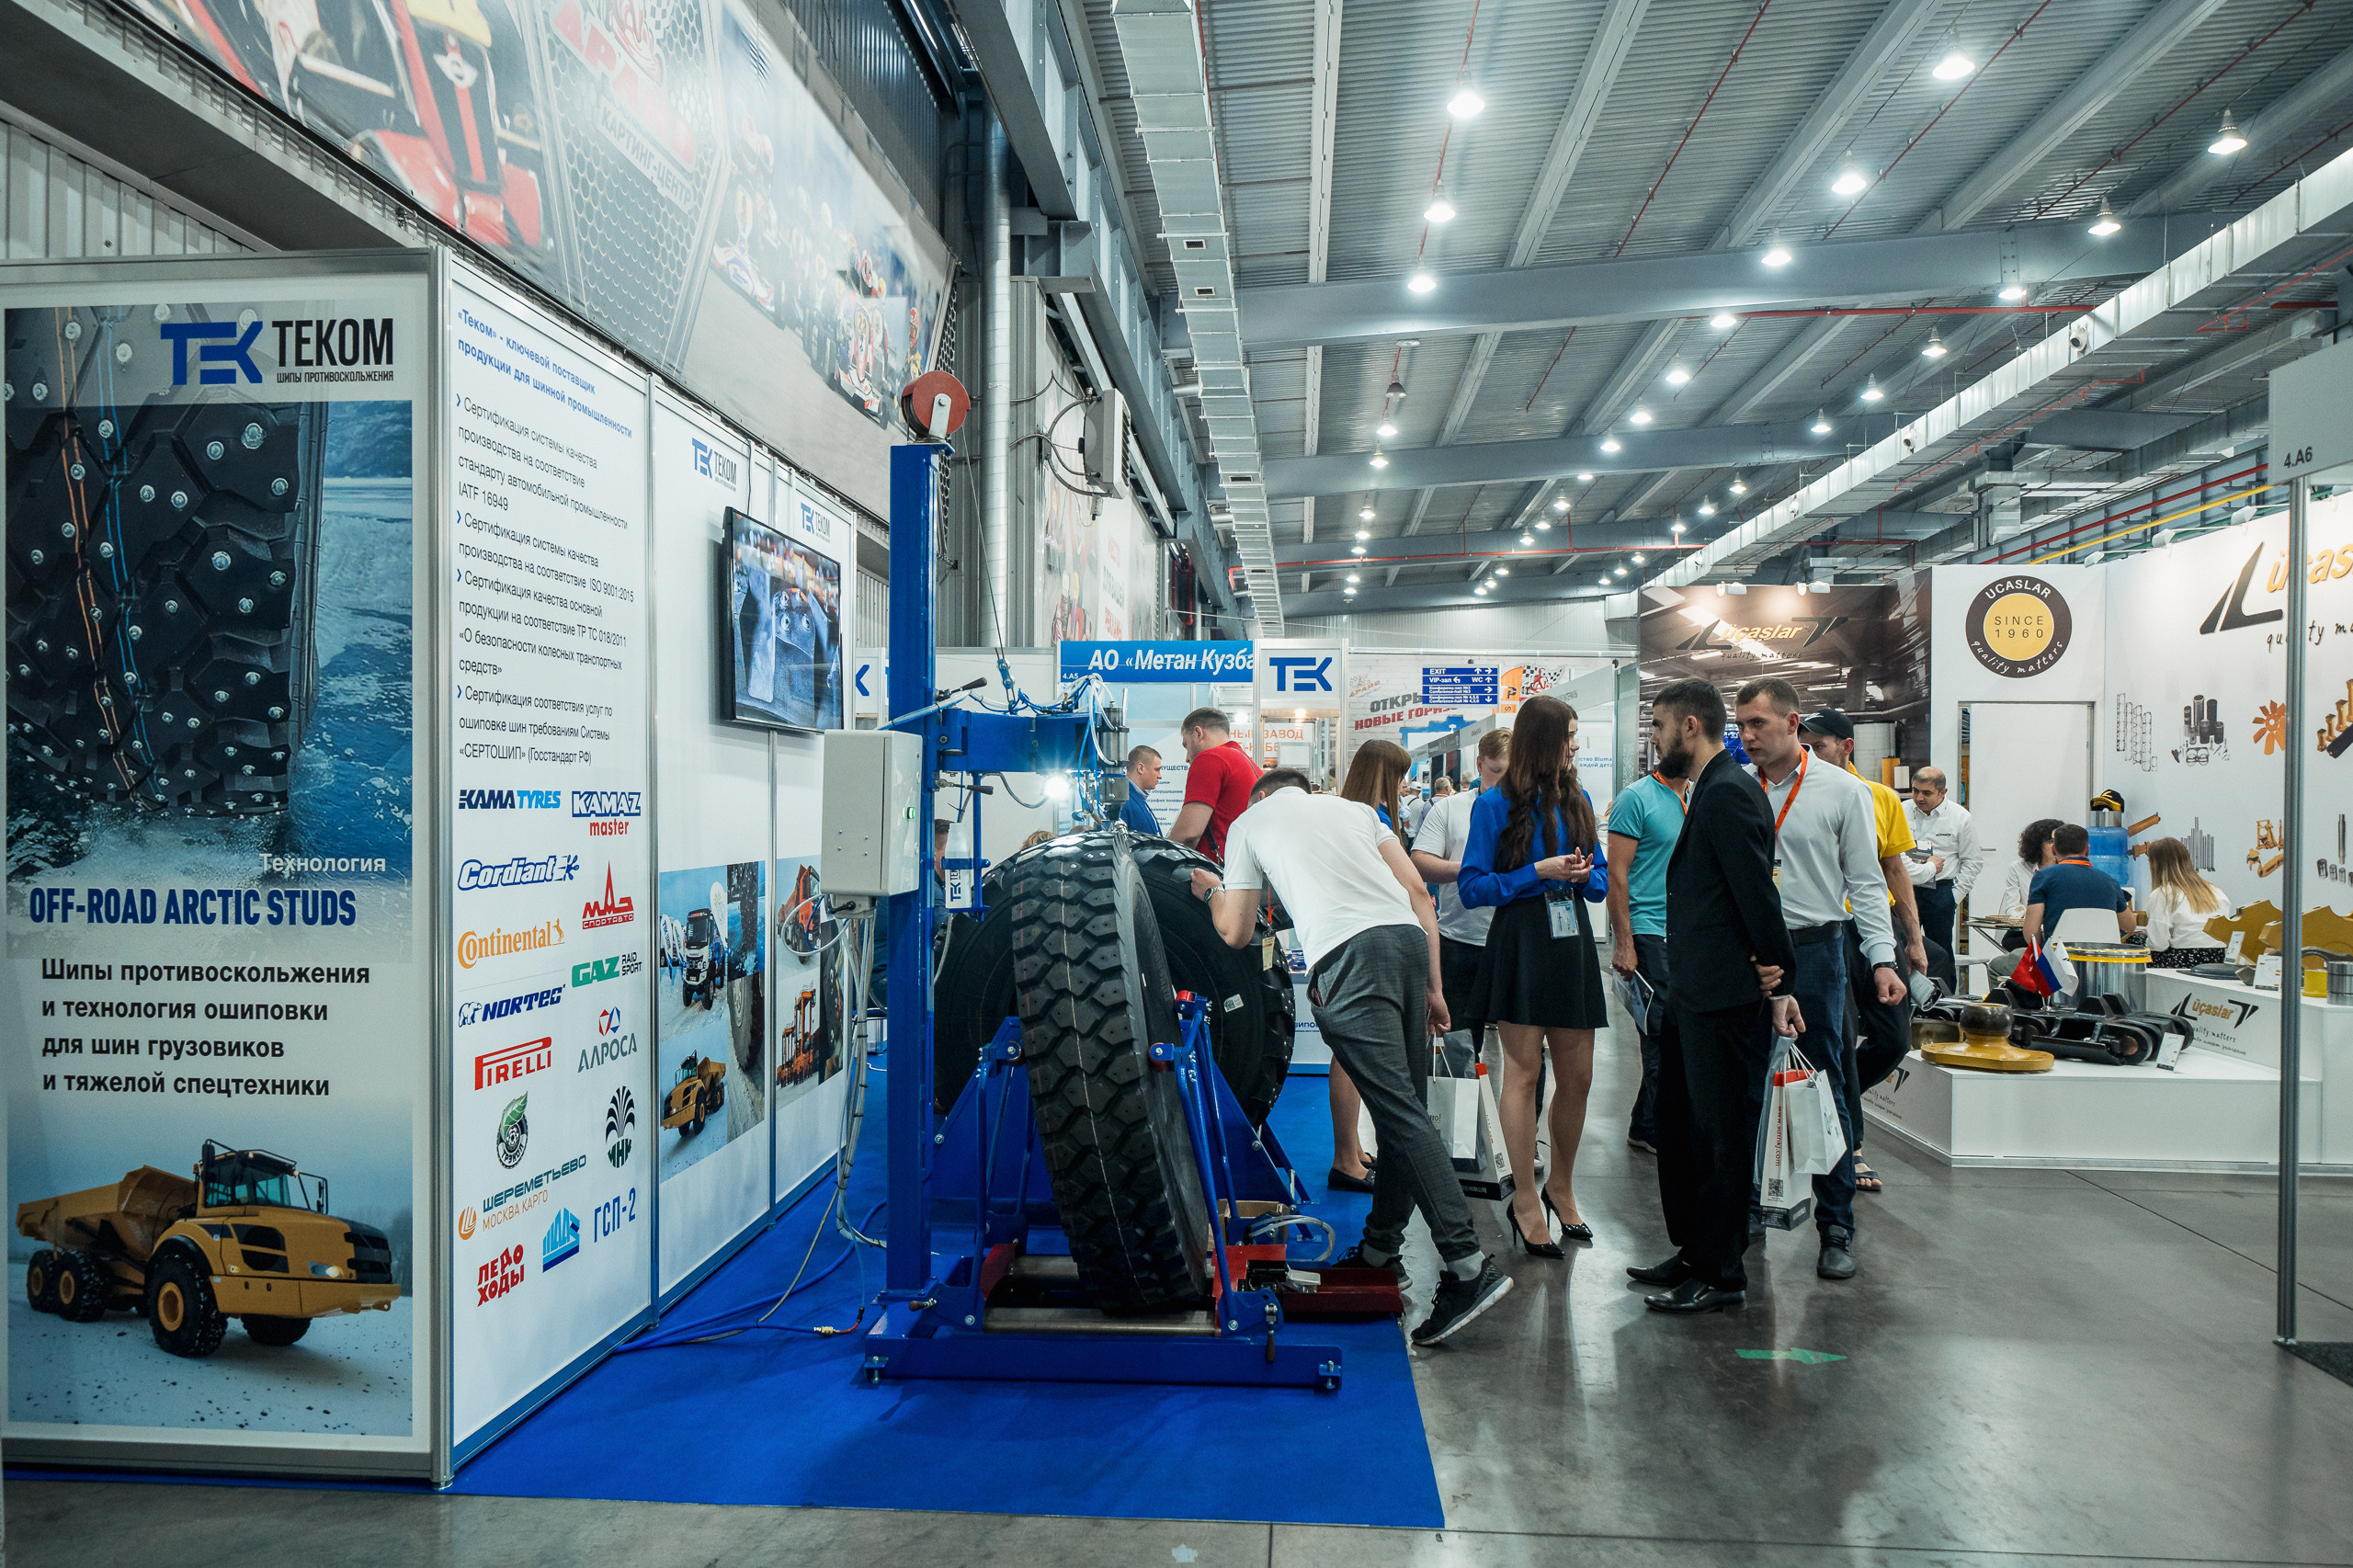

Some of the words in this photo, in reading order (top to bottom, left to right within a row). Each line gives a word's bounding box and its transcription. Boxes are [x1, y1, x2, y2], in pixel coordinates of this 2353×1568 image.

[602, 106, 694, 206] КАРТИНГ-ЦЕНТР
[272, 318, 393, 367] ТЕКОМ
[459, 308, 496, 338] «Теком»
[506, 336, 550, 369] ключевой
[552, 362, 596, 394] поставщик
[277, 371, 301, 383] ШИПЫ
[304, 369, 393, 382] ПРОТИВОСКОЛЬЖЕНИЯ
[459, 339, 511, 375] продукции
[514, 368, 529, 384] для
[533, 378, 565, 403] шинной
[568, 396, 631, 438] промышленности
[464, 397, 529, 437] Сертификация
[531, 430, 563, 453] системы
[566, 447, 597, 469] качества
[459, 426, 521, 462] производства
[524, 455, 533, 467] на
[536, 458, 585, 488] соответствие
[714, 451, 736, 484] ТЕКОМ
[2284, 446, 2312, 468] 4.A6
[459, 456, 505, 484] стандарту
[507, 472, 569, 506] автомобильной
[571, 497, 628, 529] промышленности
[459, 481, 479, 500] IATF
[483, 490, 508, 511] 16949
[464, 513, 530, 546] Сертификация
[533, 536, 565, 556] системы
[568, 548, 598, 568] качества
[460, 543, 522, 570] производства
[525, 562, 535, 573] на
[537, 564, 586, 588] соответствие
[589, 578, 601, 593] ISO
[603, 583, 634, 602] 9001:2015
[2266, 543, 2353, 593] üas
[465, 571, 531, 599] Сертификация
[534, 585, 568, 609] качества
[570, 600, 602, 618] основной
[1985, 579, 2052, 599] UCASLAR
[460, 601, 509, 621] продукции
[512, 612, 521, 623] на
[524, 614, 575, 636] соответствие
[599, 629, 626, 647] 018/2011
[1995, 616, 2043, 625] SINCE
[1995, 629, 2043, 638] 1960
[2267, 619, 2324, 653] quty
[460, 628, 472, 642] «О
[475, 630, 536, 654] безопасности
[539, 643, 574, 662] колесных
[576, 653, 621, 671] транспортных
[1088, 649, 1119, 670] АО
[1126, 649, 1197, 670] «Метан
[1201, 648, 1253, 675] Кузба
[1721, 651, 1756, 661] quality
[1971, 641, 2009, 674] quality
[2018, 642, 2063, 673] matters
[460, 658, 502, 676] средств»
[465, 686, 531, 708] Сертификация
[534, 695, 584, 712] соответствия
[585, 704, 603, 718] услуг
[605, 707, 612, 717] по
[460, 717, 506, 732] ошиповке
[509, 721, 526, 733] шин
[529, 722, 578, 738] требованиям
[581, 725, 609, 740] Системы
[1264, 730, 1303, 740] ЗАВОД
[1355, 711, 1404, 731] НОВЫЕ
[460, 743, 525, 760] «СЕРТОШИП»
[529, 746, 576, 764] (Госстандарт
[579, 751, 592, 766] РФ)
[459, 790, 515, 809] KAMA
[517, 790, 561, 808] TYRES
[572, 791, 641, 817] KAMAZ
[589, 819, 629, 836] master
[258, 853, 386, 872] Технология
[458, 856, 564, 891] Cordiant
[30, 888, 157, 924] OFF-ROAD
[164, 889, 260, 925] ARCTIC
[267, 889, 356, 926] STUDS
[583, 914, 633, 928] СПОРТАВТО
[458, 922, 551, 969] Continental
[622, 952, 637, 963] RAID
[42, 958, 112, 980] Шипы
[120, 964, 369, 985] противоскольжения
[572, 956, 620, 987] GAZ
[622, 962, 642, 975] SPORT
[42, 999, 55, 1016] и
[63, 999, 196, 1018] технология
[204, 1002, 327, 1021] ошиповки
[482, 985, 563, 1021] NORTEC
[2192, 998, 2234, 1019] üçaslar
[2193, 1026, 2209, 1037] uality
[42, 1038, 83, 1056] для
[91, 1038, 140, 1055] шин
[148, 1038, 284, 1060] грузовиков
[475, 1037, 551, 1090] PIRELLI
[578, 1033, 637, 1073] АЛРОСА
[42, 1074, 55, 1090] и
[64, 1071, 165, 1093] тяжелой
[174, 1074, 329, 1097] спецтехники
[483, 1154, 586, 1213] ШЕРЕМЕТЬЕВО
[483, 1203, 520, 1232] МОСКВА
[522, 1189, 548, 1215] КАРГО
[595, 1187, 636, 1243] ГСП-2
[478, 1244, 524, 1286] ЛЕДО
[478, 1265, 524, 1307] ХОДЫ
